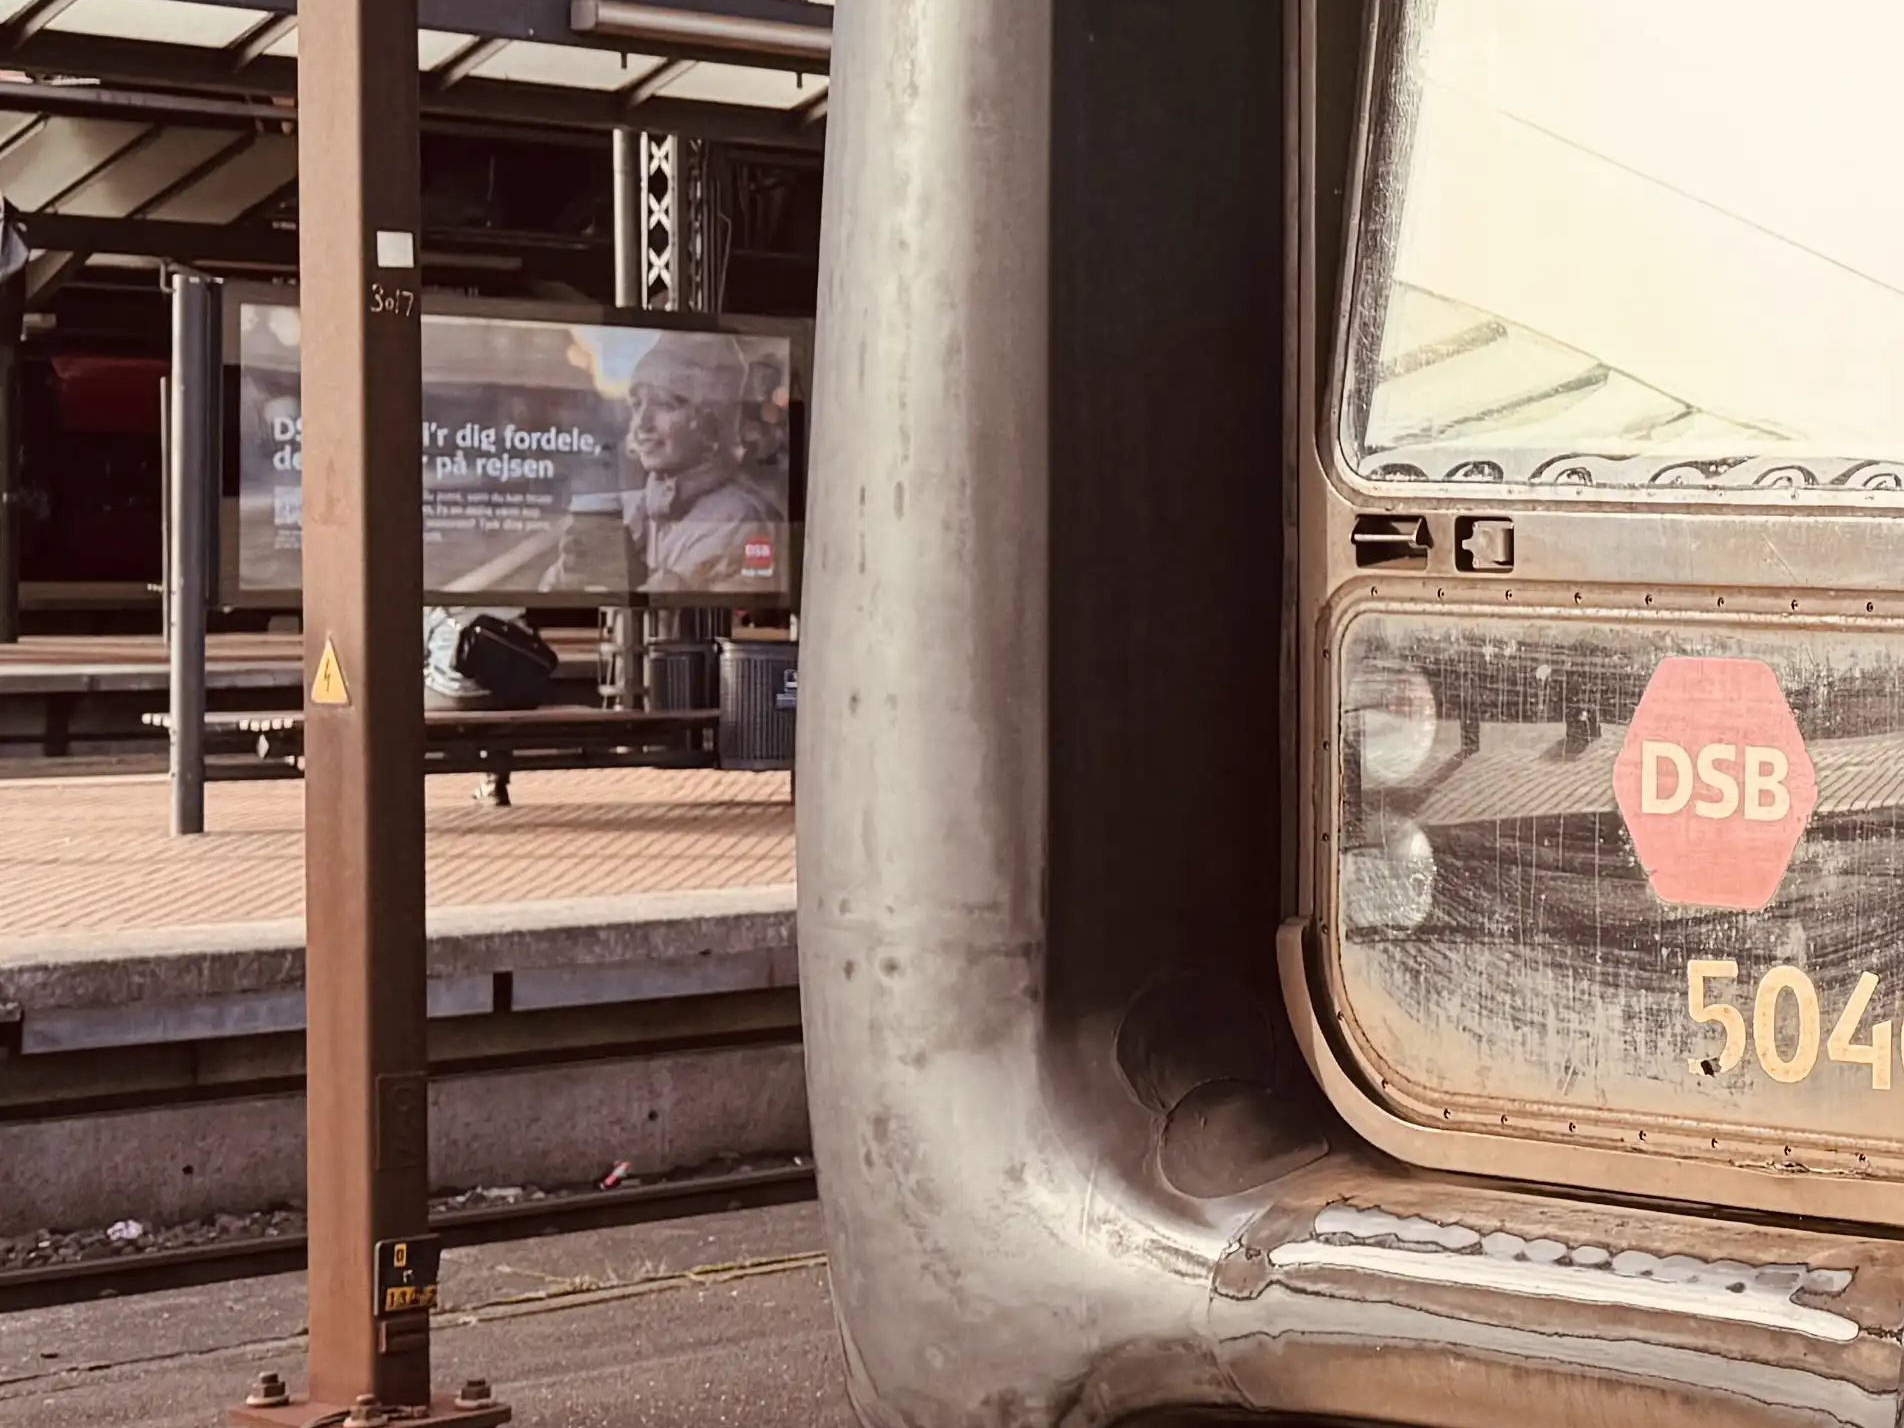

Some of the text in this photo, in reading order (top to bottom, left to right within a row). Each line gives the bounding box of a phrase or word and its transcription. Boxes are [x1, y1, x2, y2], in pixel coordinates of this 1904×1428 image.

[456, 422, 496, 453] dig
[504, 424, 601, 457] fordele,
[436, 449, 468, 480] på
[475, 452, 555, 482] rejsen
[1640, 739, 1791, 821] DSB
